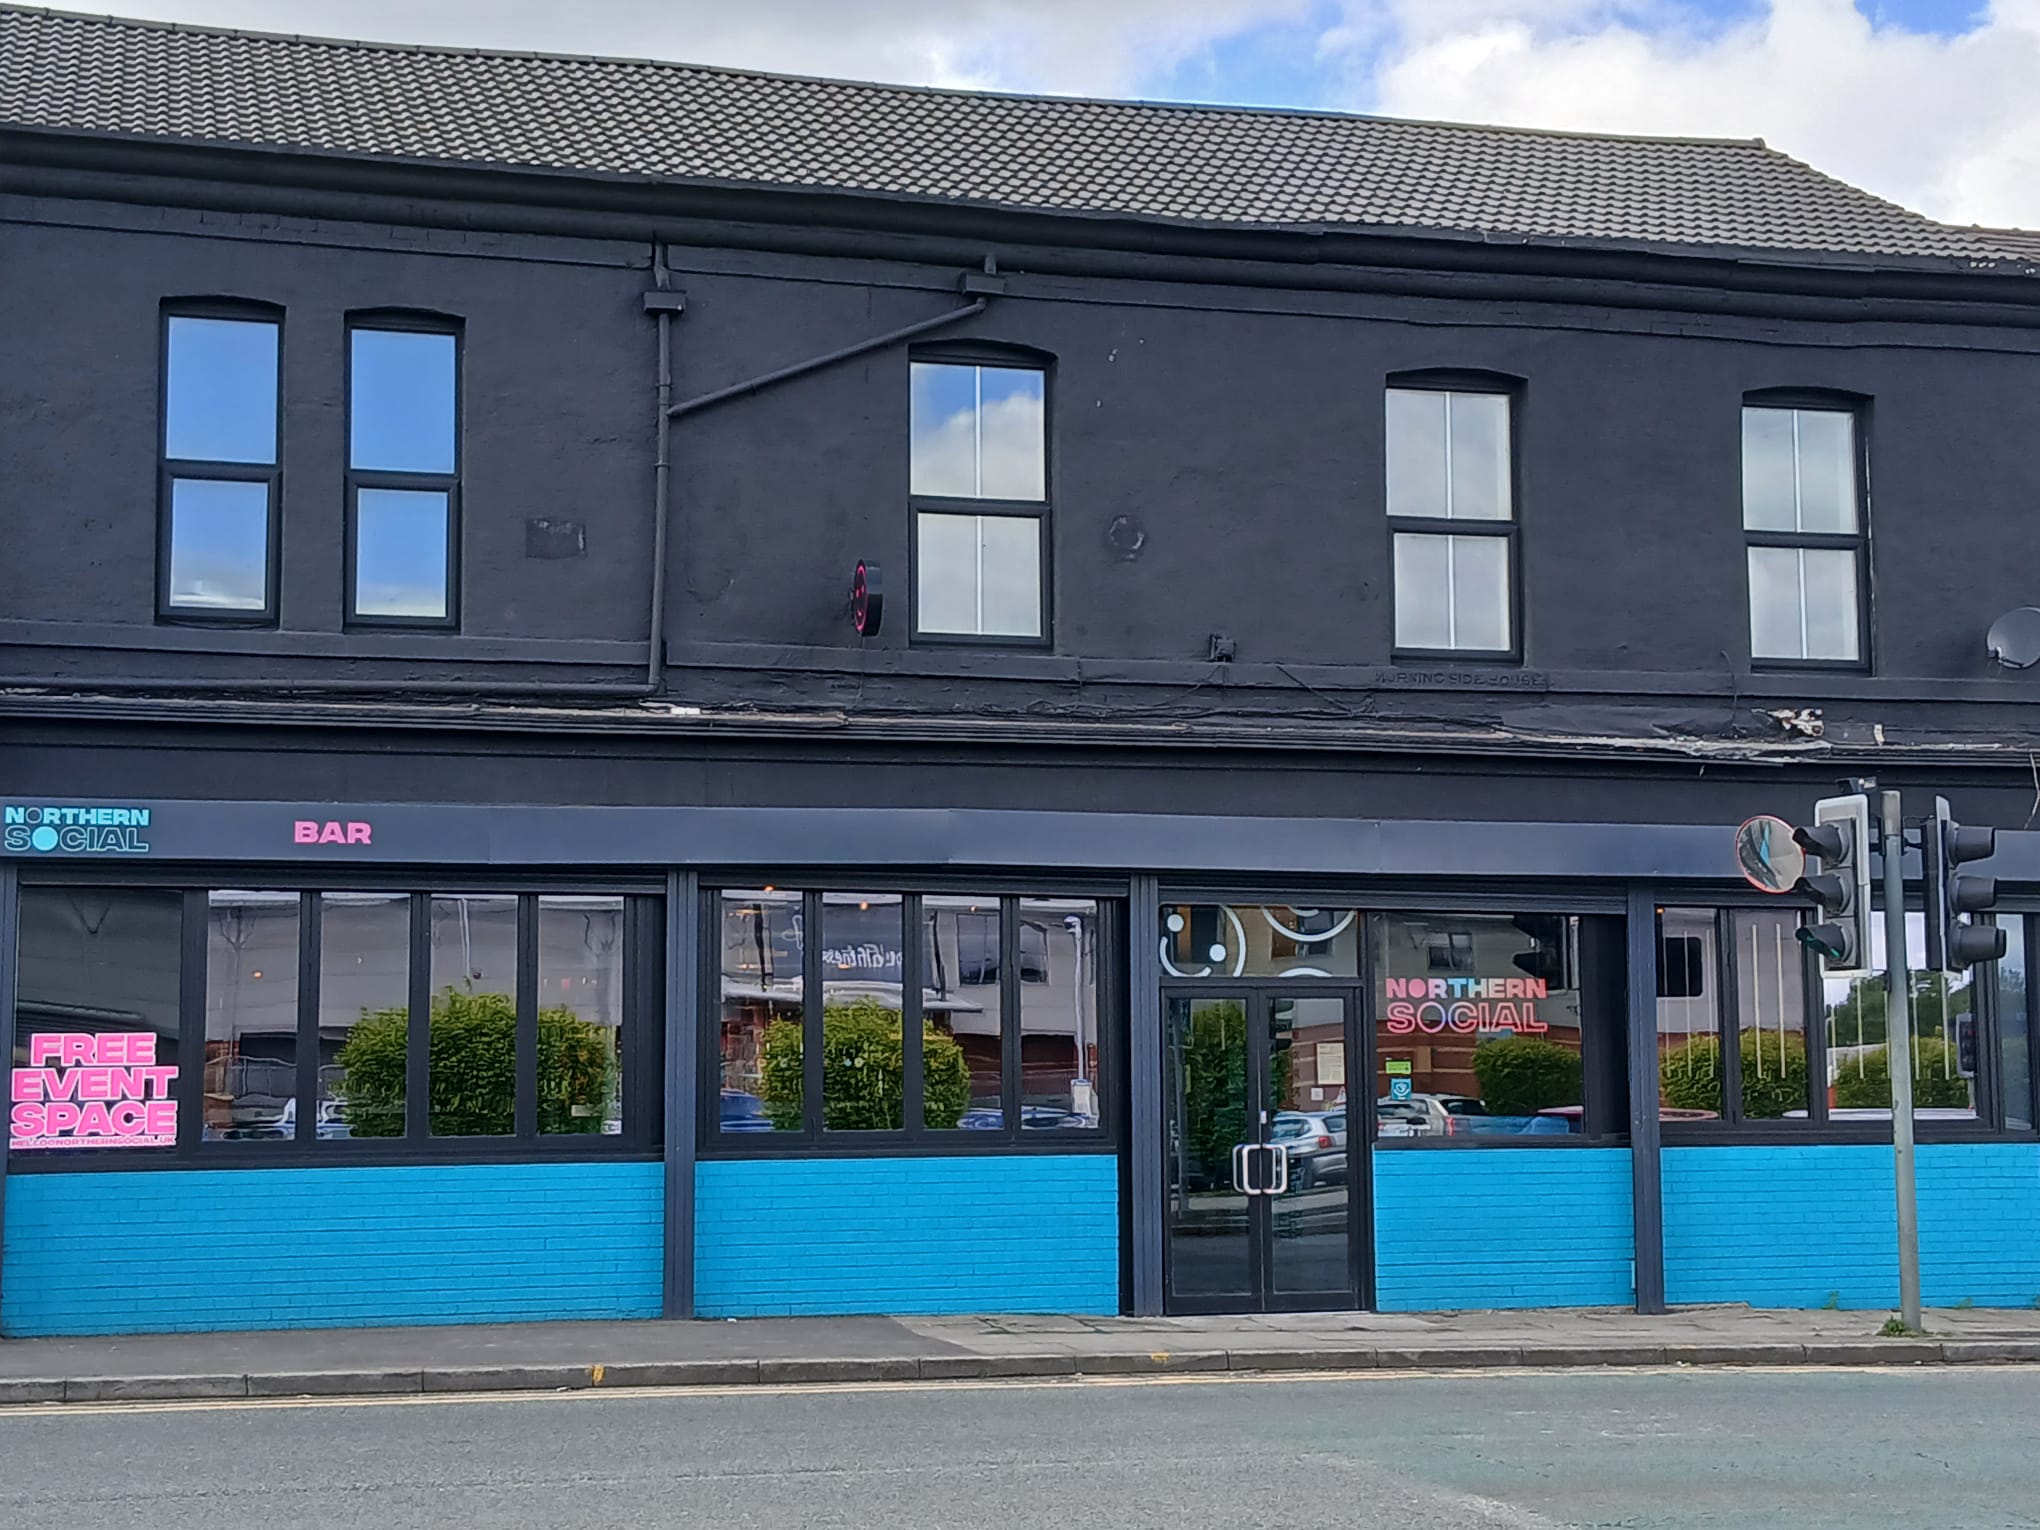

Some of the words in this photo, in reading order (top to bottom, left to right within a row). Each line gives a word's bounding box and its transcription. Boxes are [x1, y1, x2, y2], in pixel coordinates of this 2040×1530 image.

[5, 806, 149, 826] NORTHERN
[5, 826, 149, 852] SOCIAL
[294, 820, 373, 845] BAR
[1386, 978, 1547, 999] NORTHERN
[1387, 1001, 1548, 1033] SOCIAL
[31, 1033, 157, 1066] FREE
[12, 1067, 179, 1101] EVENT
[10, 1101, 178, 1137] SPACE
